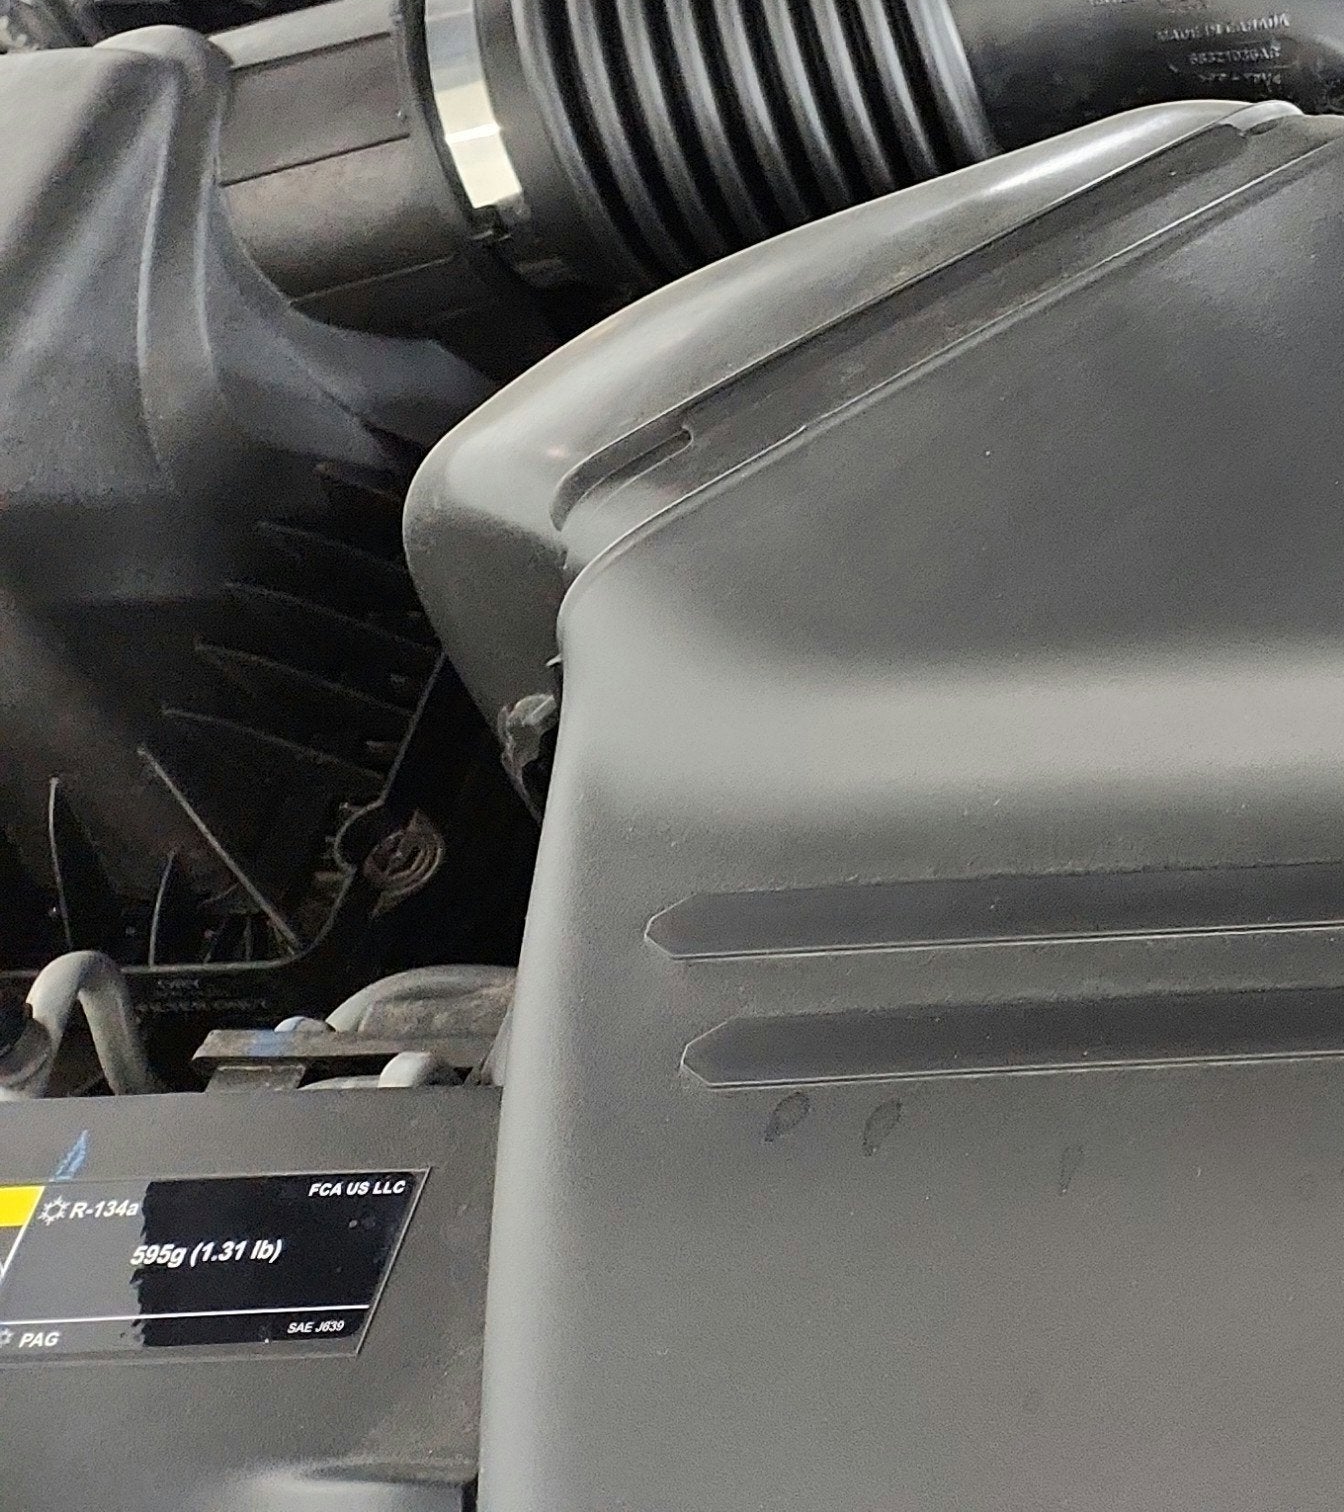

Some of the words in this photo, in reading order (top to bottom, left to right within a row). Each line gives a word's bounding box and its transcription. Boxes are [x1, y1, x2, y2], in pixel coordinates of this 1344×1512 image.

[308, 1182, 342, 1198] FCA
[346, 1182, 370, 1196] US
[374, 1180, 406, 1195] LLC
[70, 1199, 140, 1219] R-134a
[130, 1244, 187, 1269] 595g
[189, 1240, 248, 1267] (1.31
[251, 1239, 283, 1263] lb)
[286, 1322, 314, 1335] SAE
[18, 1330, 60, 1349] PAG
